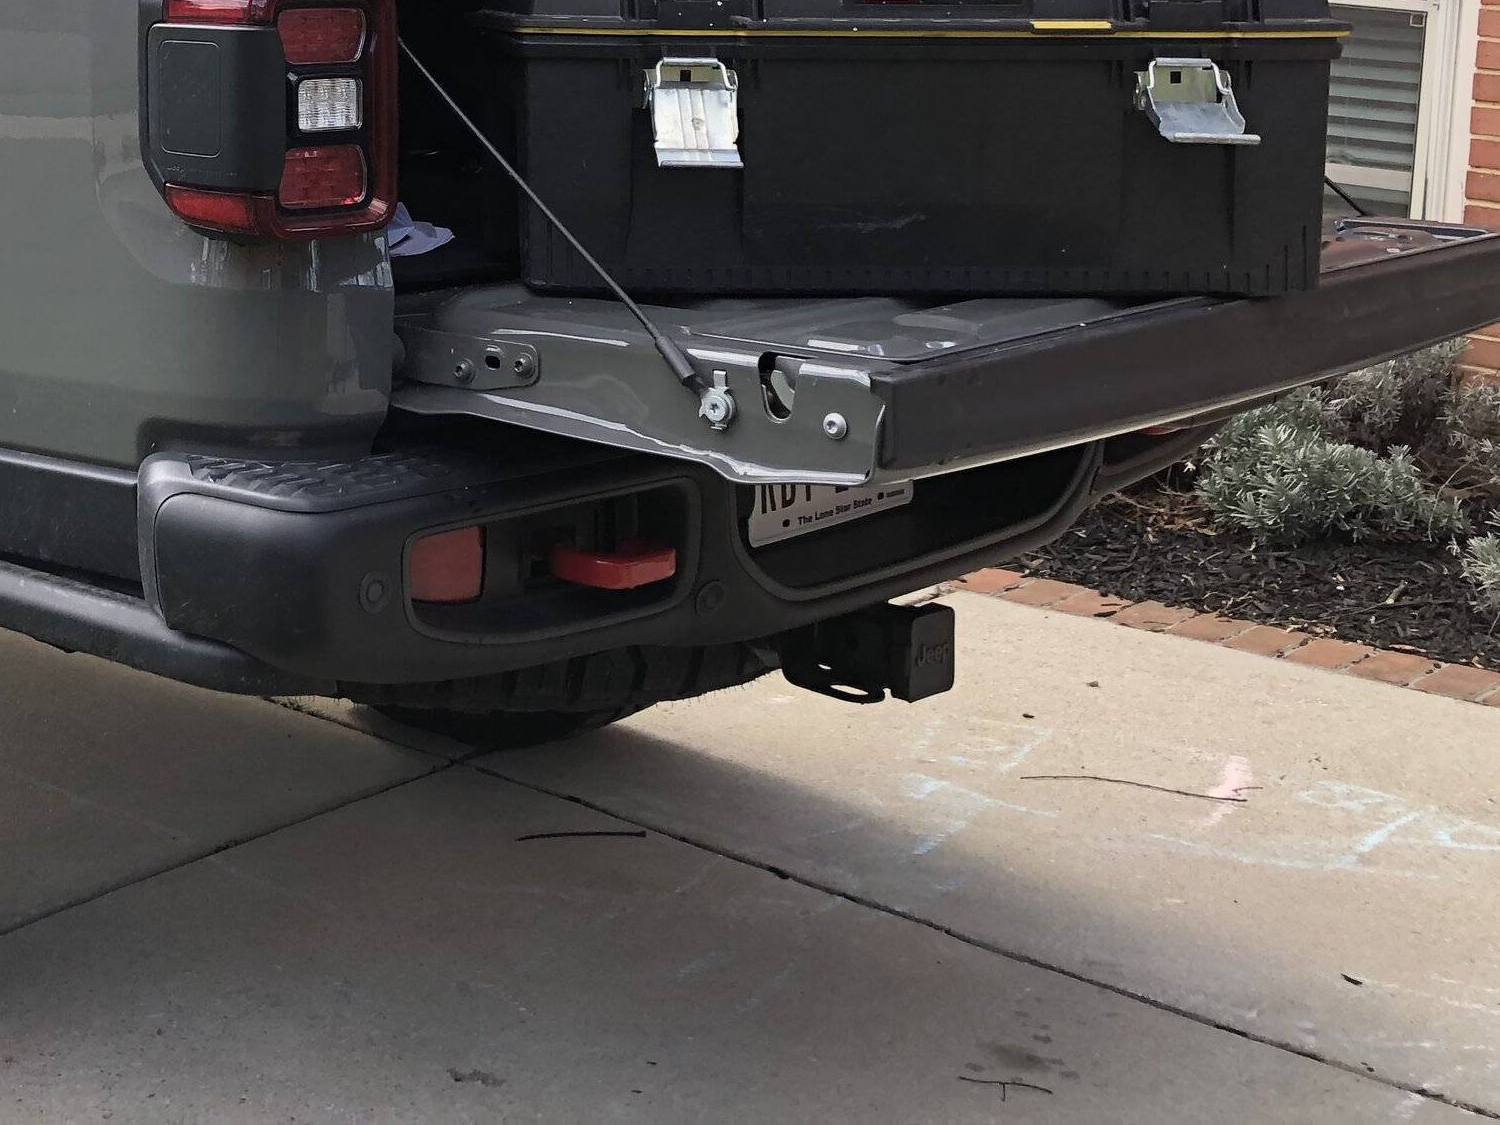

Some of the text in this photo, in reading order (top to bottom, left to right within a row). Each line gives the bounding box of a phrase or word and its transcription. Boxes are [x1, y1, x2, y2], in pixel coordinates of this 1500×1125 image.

[798, 497, 873, 526] The Lone Star State
